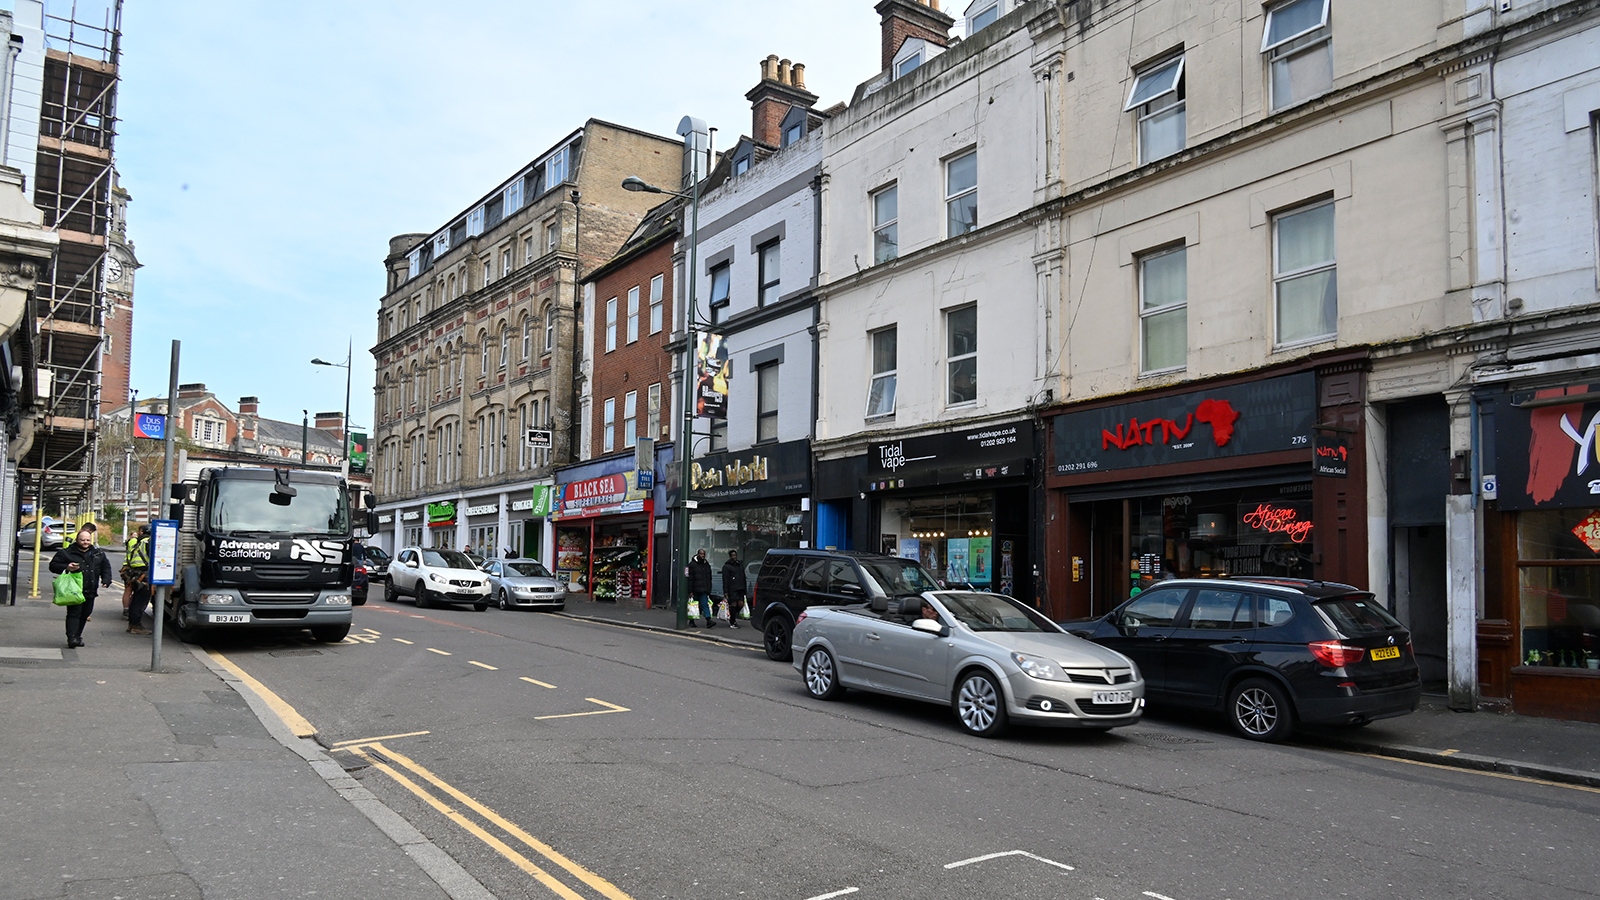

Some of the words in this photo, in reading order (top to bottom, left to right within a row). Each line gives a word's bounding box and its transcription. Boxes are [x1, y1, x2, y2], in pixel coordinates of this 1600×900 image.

[146, 416, 161, 424] bus
[142, 424, 160, 432] stop
[967, 427, 1016, 441] www.tidalvape.co.uk
[980, 439, 995, 447] 01202
[1007, 436, 1016, 444] 164
[1291, 435, 1307, 445] 276
[879, 441, 902, 458] Tidal
[881, 456, 906, 472] vape
[1057, 464, 1075, 472] 01202
[1087, 461, 1098, 469] 696
[1319, 465, 1334, 473] African
[1334, 466, 1346, 474] Social
[725, 455, 768, 486] World
[574, 483, 598, 498] BLACK
[599, 477, 615, 494] SEA
[573, 494, 614, 508] SUPERMARKET
[1243, 504, 1296, 529] African
[1263, 517, 1314, 543] Dining
[219, 540, 280, 550] Advanced
[219, 549, 271, 560] Scaffolding
